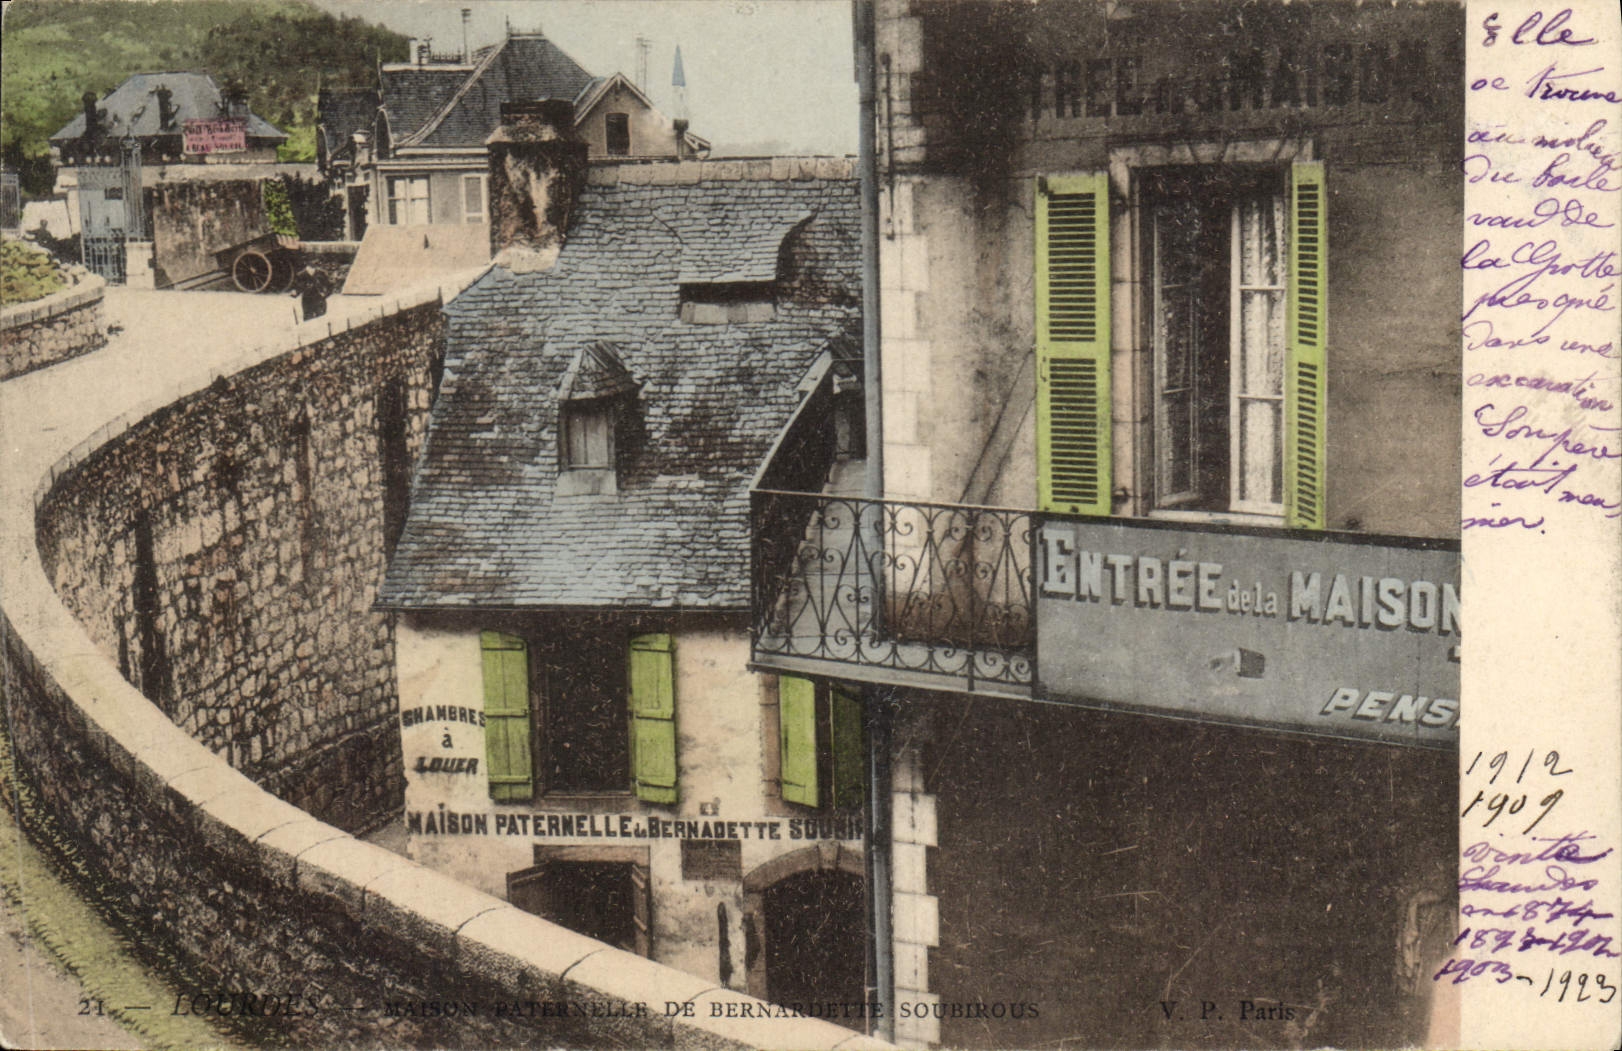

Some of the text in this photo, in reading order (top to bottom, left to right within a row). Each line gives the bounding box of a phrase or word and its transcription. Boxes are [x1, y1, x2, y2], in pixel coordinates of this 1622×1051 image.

[1482, 9, 1599, 47] Elle
[1461, 239, 1622, 295] la Grotte
[1226, 578, 1250, 615] de
[1253, 581, 1278, 617] la
[1288, 570, 1461, 636] MAISON
[402, 705, 485, 728] CHAMBRES
[441, 727, 453, 749] à
[414, 756, 479, 776] LOUER
[1466, 749, 1573, 784] 1912
[407, 803, 488, 835] MAISON
[495, 814, 632, 837] PATERNELLE
[648, 817, 781, 840] BERNADETTE
